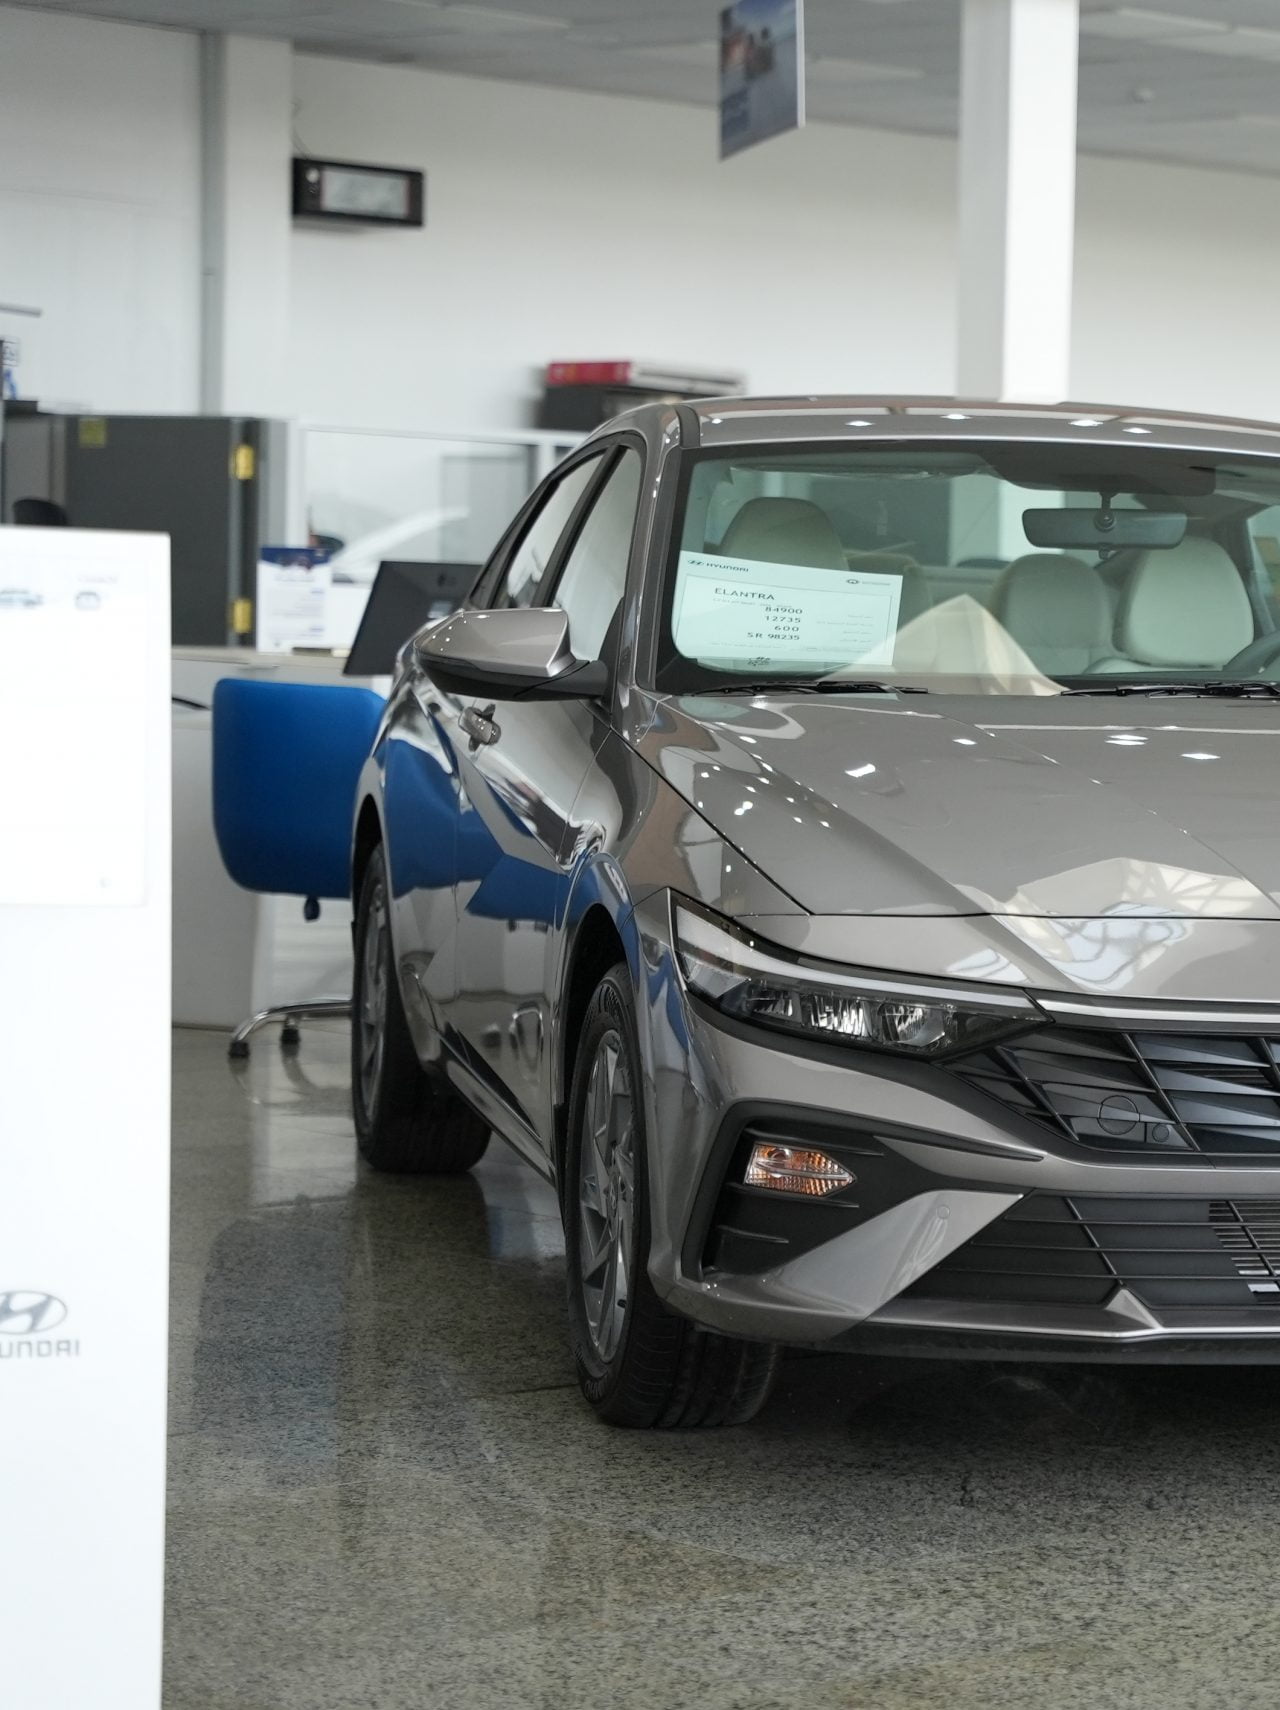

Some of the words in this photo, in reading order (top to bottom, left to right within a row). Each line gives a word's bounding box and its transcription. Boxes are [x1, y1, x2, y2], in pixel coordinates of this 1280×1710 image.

[706, 562, 749, 572] HYUNDAI
[714, 587, 775, 600] ELANTRA
[765, 606, 803, 614] 84900
[766, 615, 801, 623] 12735
[0, 1339, 80, 1359] UNDAI
